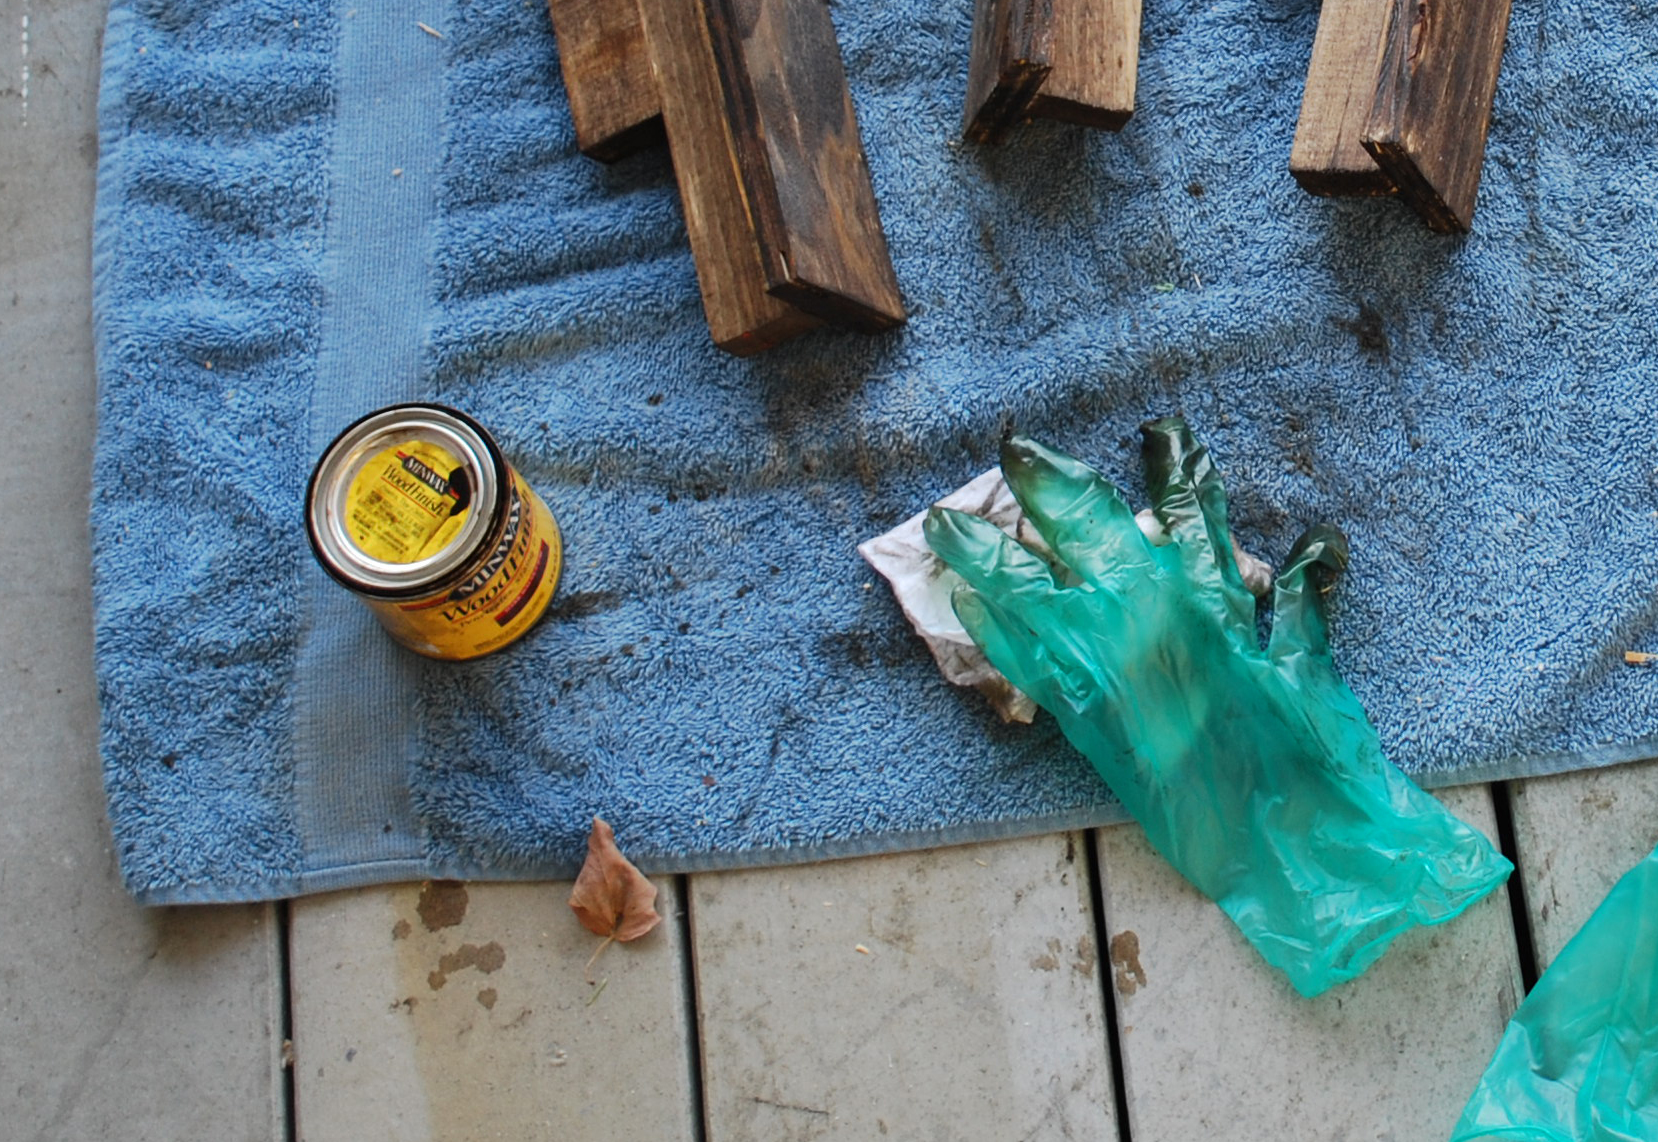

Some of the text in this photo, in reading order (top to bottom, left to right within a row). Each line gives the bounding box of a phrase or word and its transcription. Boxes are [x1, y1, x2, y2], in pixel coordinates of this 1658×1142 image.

[383, 464, 413, 492] Wood
[409, 484, 445, 516] Finish
[406, 458, 448, 494] MINWAX
[458, 494, 521, 596] MINWAX
[441, 566, 511, 622] Wood
